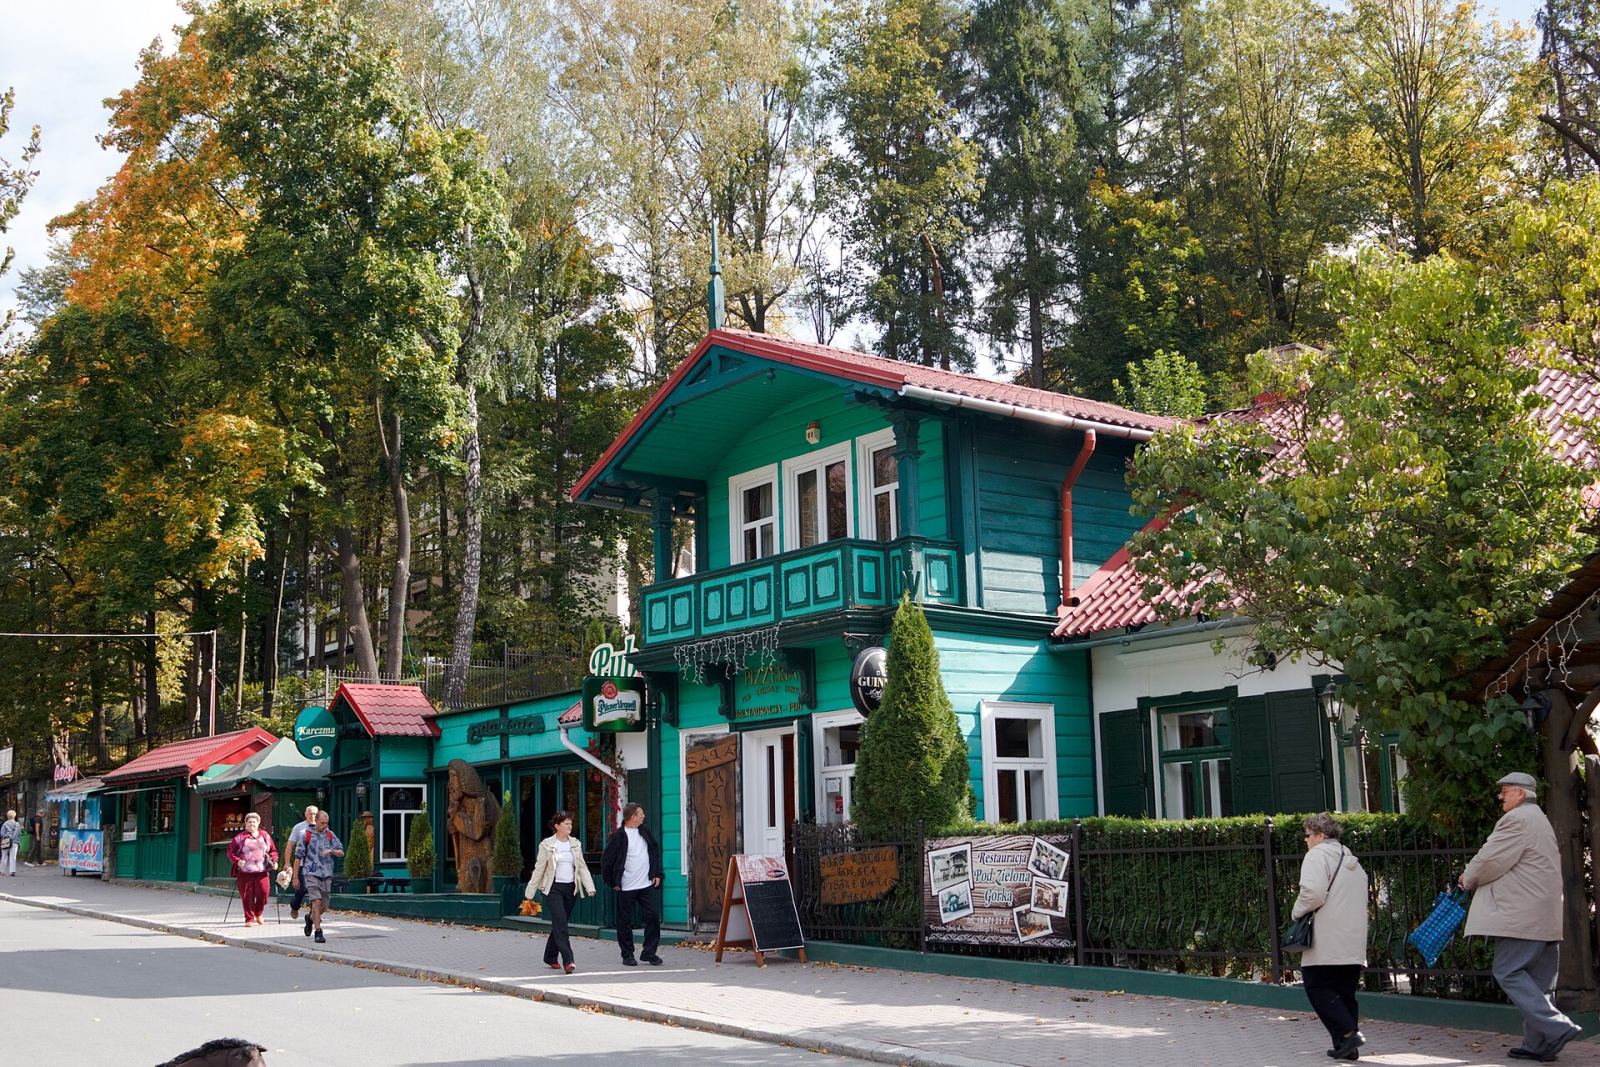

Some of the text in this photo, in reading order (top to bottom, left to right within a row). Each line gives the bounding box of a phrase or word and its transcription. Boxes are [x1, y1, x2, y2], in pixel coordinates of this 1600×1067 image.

[858, 676, 888, 688] GUIN
[598, 700, 636, 716] Pilsner Urquell
[297, 726, 336, 736] Karczma
[54, 764, 75, 782] Lody
[69, 836, 101, 858] Lody
[978, 850, 1027, 865] Restauracja
[974, 867, 1031, 886] Pod Zieloną
